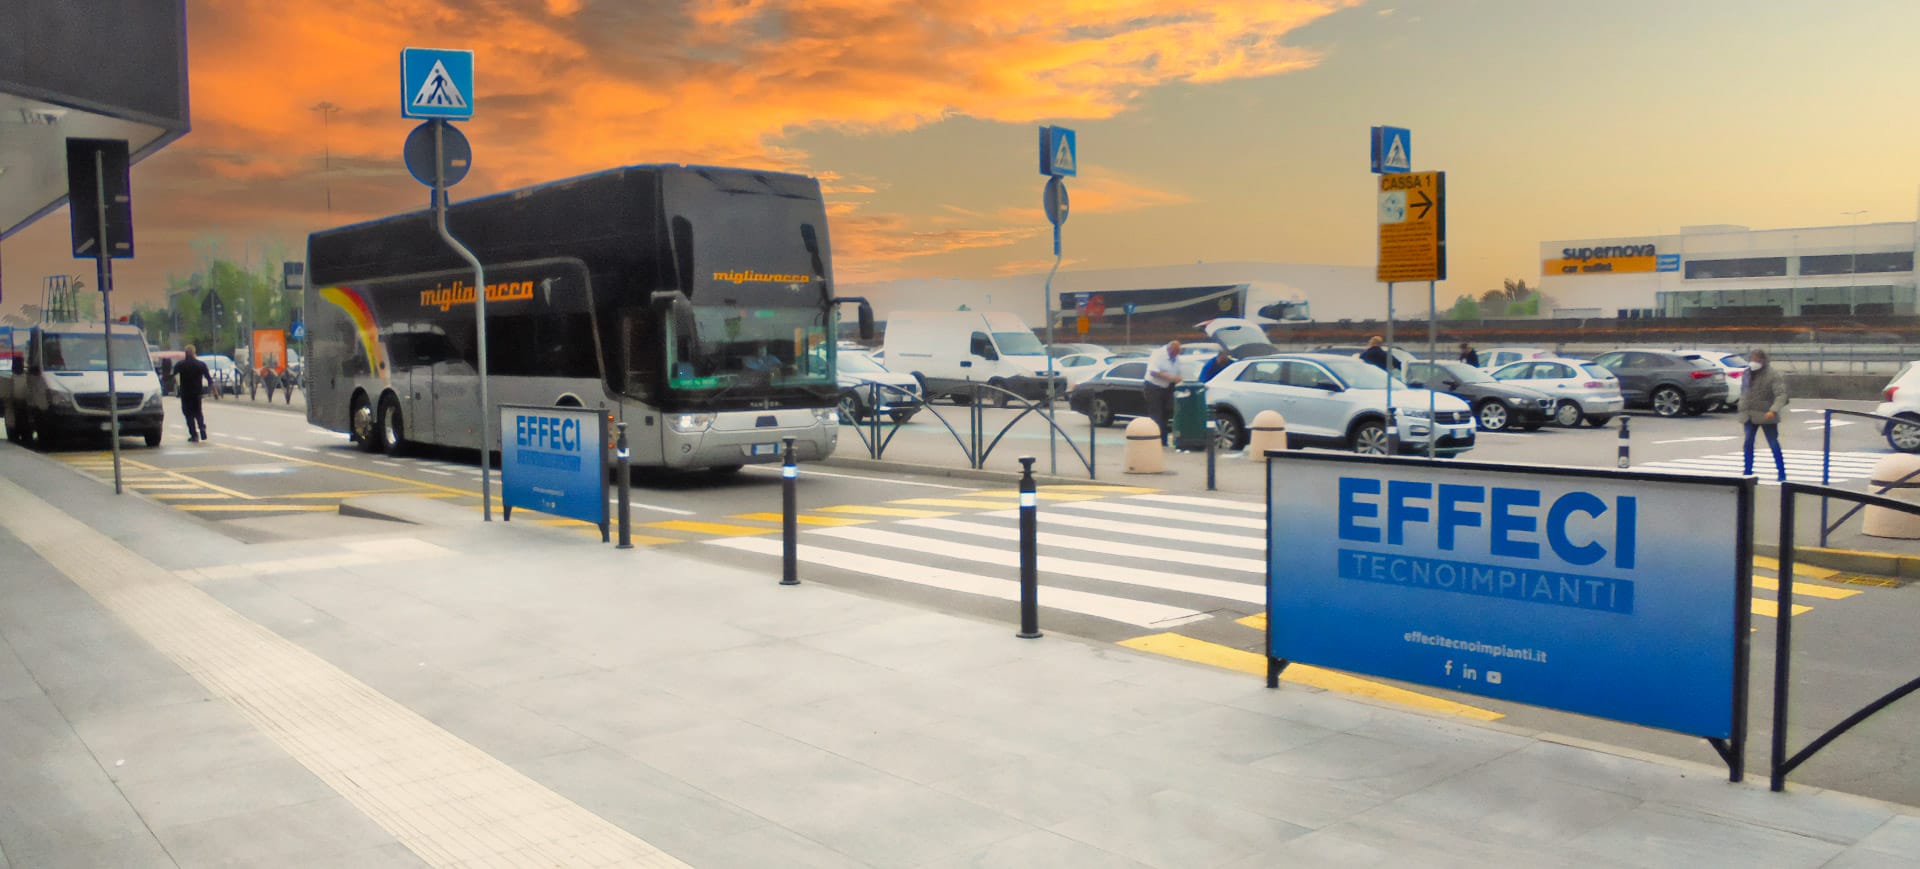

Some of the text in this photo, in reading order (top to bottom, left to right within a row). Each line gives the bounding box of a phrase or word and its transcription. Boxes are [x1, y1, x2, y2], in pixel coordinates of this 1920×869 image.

[1382, 175, 1432, 191] CASSA 1
[1562, 244, 1655, 262] supernova
[420, 280, 534, 312] migliaacca
[516, 414, 581, 453] EFFECI
[1339, 477, 1637, 570] EFFECI
[1352, 553, 1617, 608] TECNOIMPIANTI
[1403, 631, 1548, 663] effecitecnoimpianti.it
